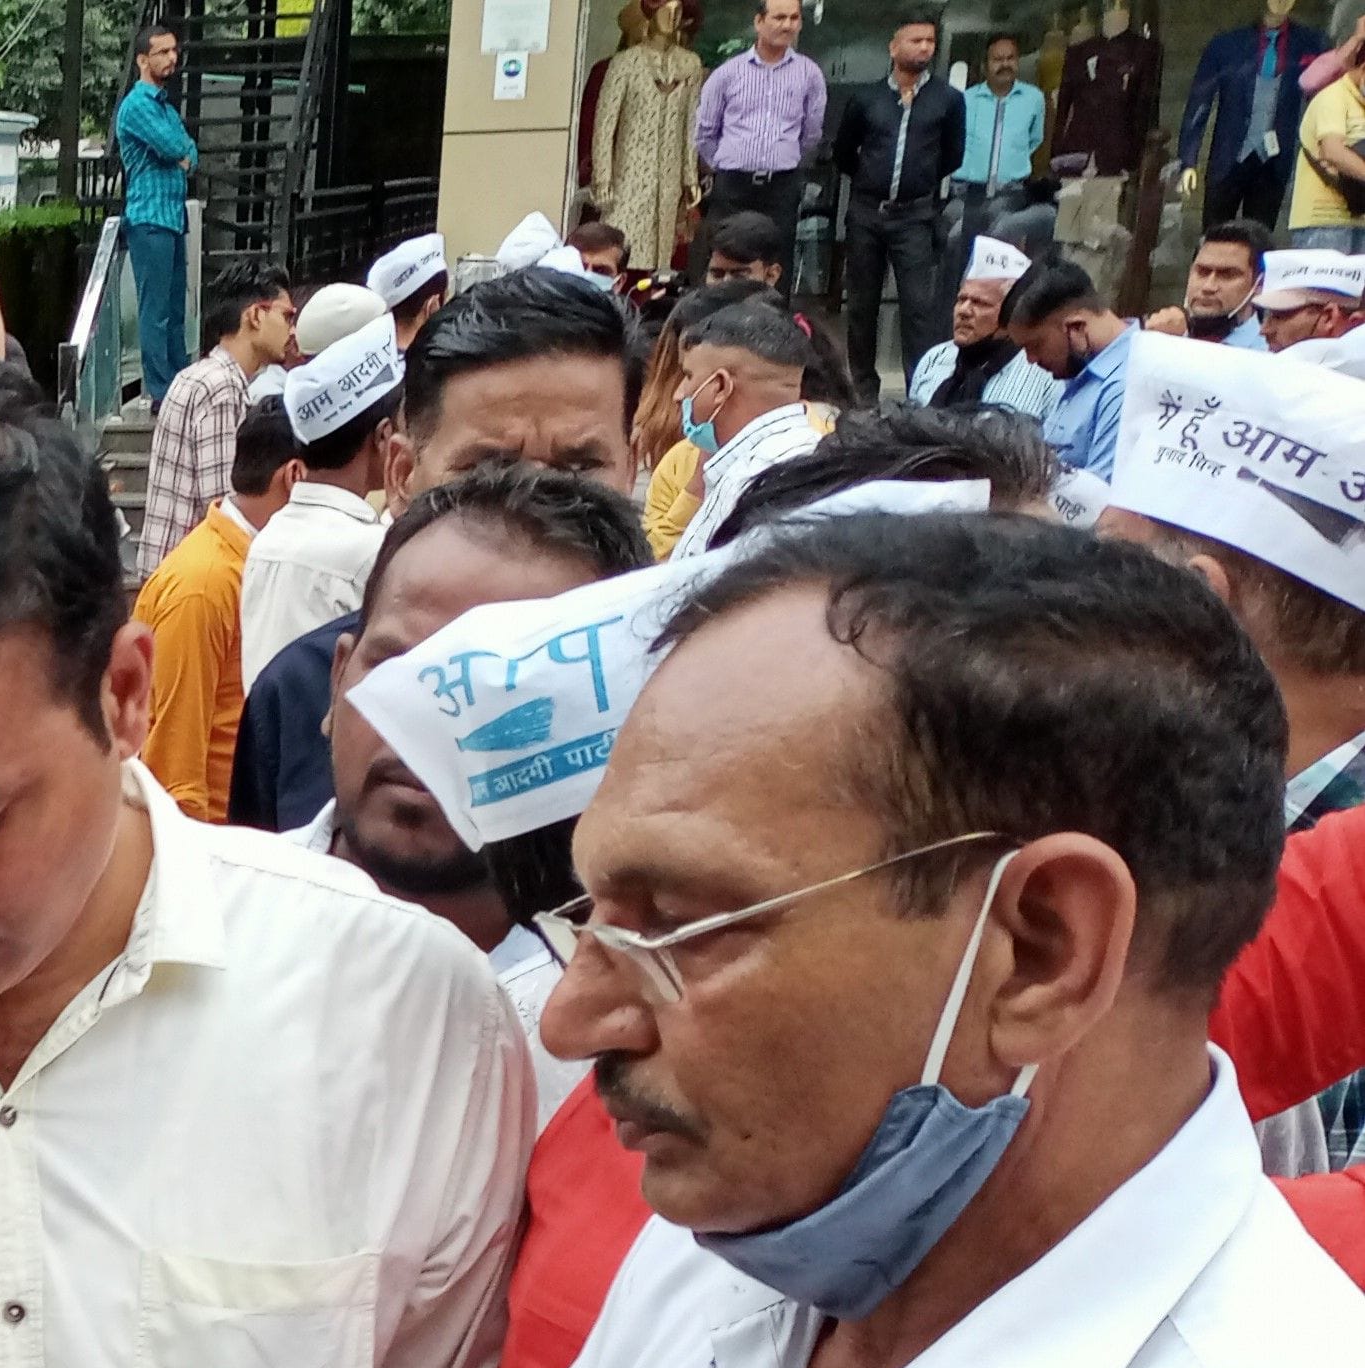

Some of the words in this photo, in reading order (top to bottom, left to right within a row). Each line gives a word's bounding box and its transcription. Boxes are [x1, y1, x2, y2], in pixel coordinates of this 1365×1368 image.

[297, 391, 334, 421] आम
[338, 351, 383, 393] आदमी
[1158, 389, 1182, 430] मैं
[1180, 396, 1222, 451] हूँ
[1223, 421, 1327, 479] आम
[493, 753, 554, 794] आदमी
